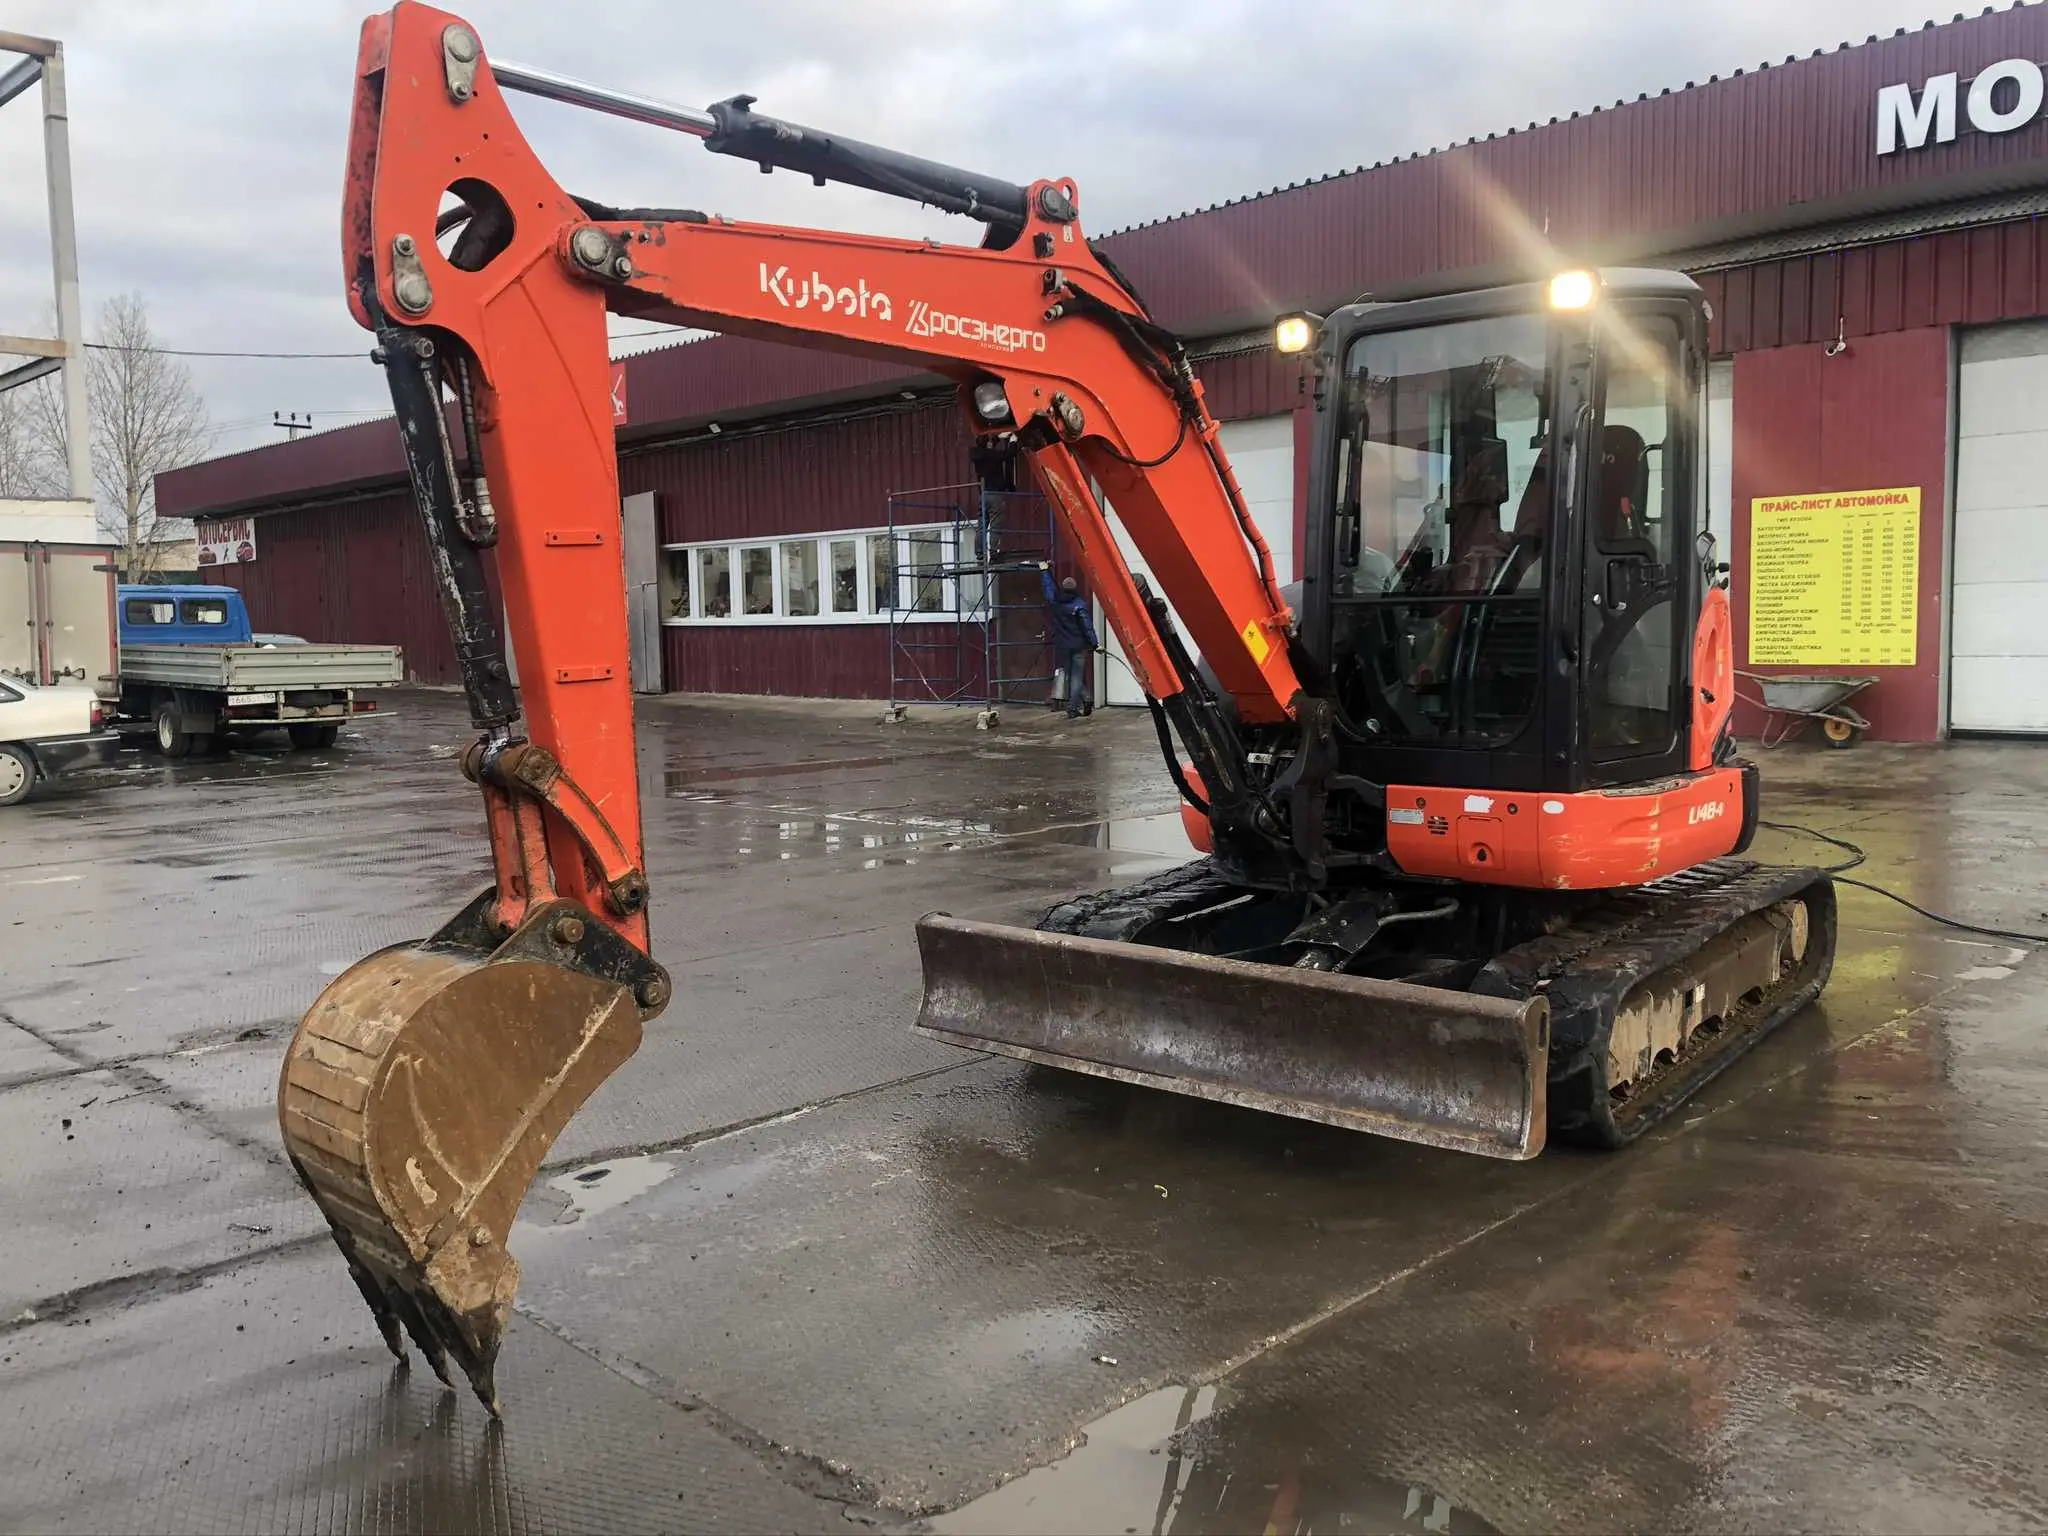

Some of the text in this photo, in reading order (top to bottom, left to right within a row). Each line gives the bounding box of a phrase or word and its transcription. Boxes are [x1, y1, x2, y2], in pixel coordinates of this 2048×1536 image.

[759, 262, 892, 321] Kubota
[1760, 492, 1909, 512] ПРАЙС-ЛИСТ АВТОМОЙКА
